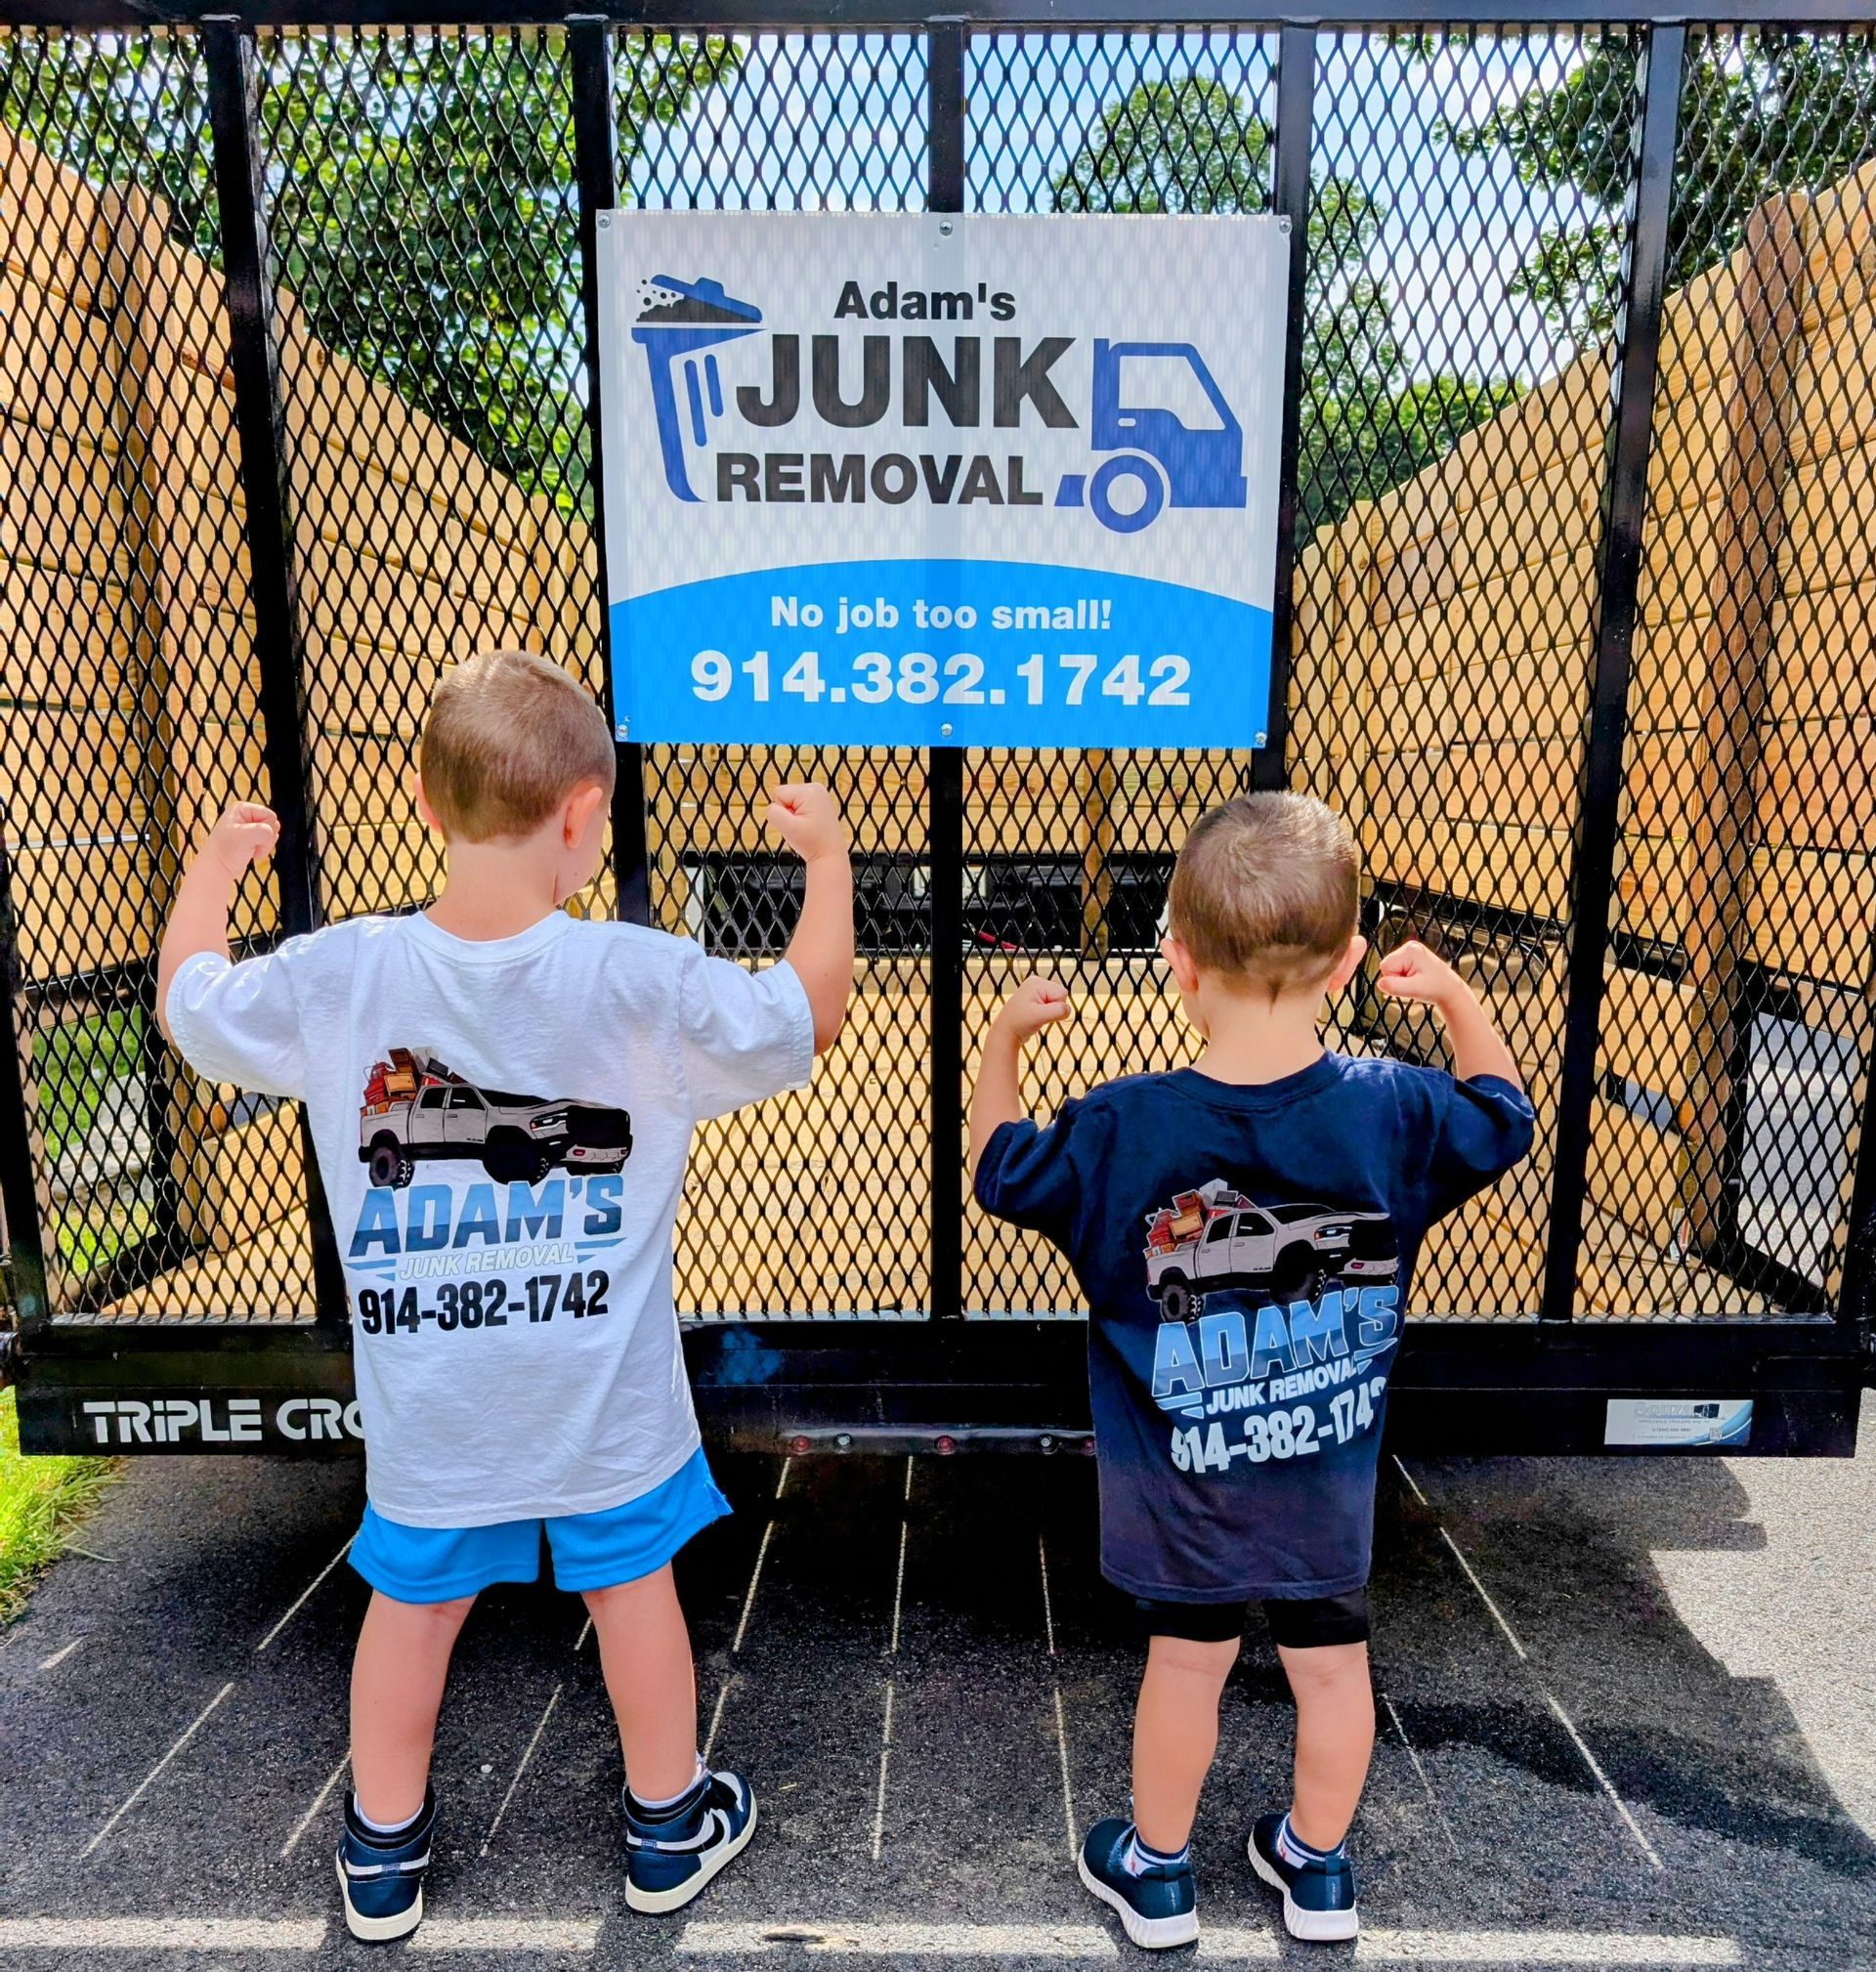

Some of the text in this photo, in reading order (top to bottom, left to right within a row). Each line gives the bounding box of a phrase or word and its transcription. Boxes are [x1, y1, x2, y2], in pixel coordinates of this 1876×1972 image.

[833, 280, 1016, 321] Adam's
[736, 334, 1080, 428] JUNK
[716, 452, 1044, 505] REMOVAL
[771, 596, 1112, 634] No job too small!
[690, 650, 1191, 706] 914.382.1742
[348, 1174, 625, 1258] ADAM'S
[399, 1243, 575, 1281] JUNK REMOVAL
[358, 1269, 611, 1335] 914-382-1742
[1151, 1285, 1399, 1397] ADAM'S
[1205, 1382, 1266, 1415] JUNK
